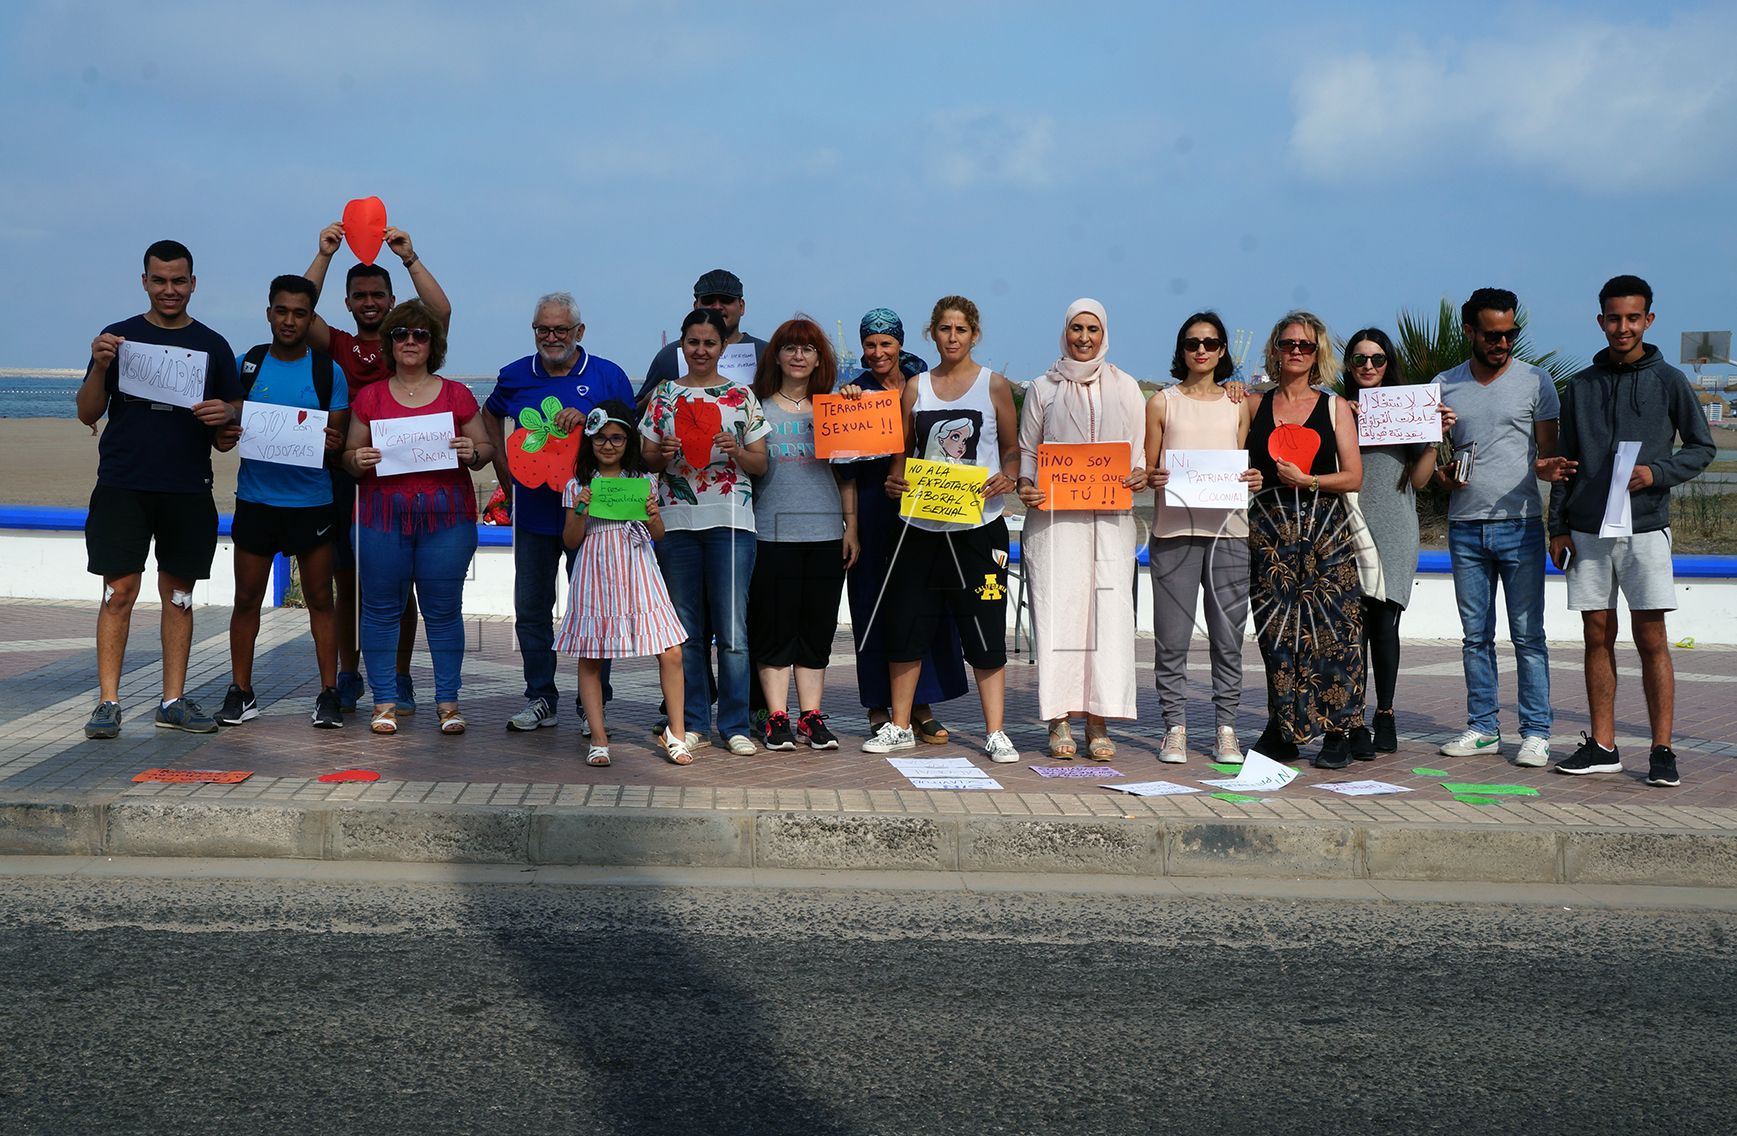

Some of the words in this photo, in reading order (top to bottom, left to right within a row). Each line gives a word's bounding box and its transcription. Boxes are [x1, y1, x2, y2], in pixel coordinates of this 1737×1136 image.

[820, 398, 893, 417] TERRORISMO
[240, 409, 289, 444] ESTOY
[821, 420, 874, 437] SEXUAL
[880, 417, 893, 435] !!
[386, 430, 453, 447] CAPITALISMO
[256, 443, 314, 460] VOSOTRAS
[411, 447, 455, 464] RACIAL
[908, 464, 923, 474] NO
[1086, 455, 1112, 468] SOY
[917, 476, 982, 495] EXPLOTACIÓN
[1051, 472, 1096, 483] MENOS
[1101, 473, 1124, 483] QUE
[907, 488, 965, 505] LABORAL
[1070, 486, 1092, 501] TÚ
[1101, 486, 1115, 505] !!
[1198, 488, 1247, 503] COLONIAL
[921, 505, 968, 516] SEXUAL
